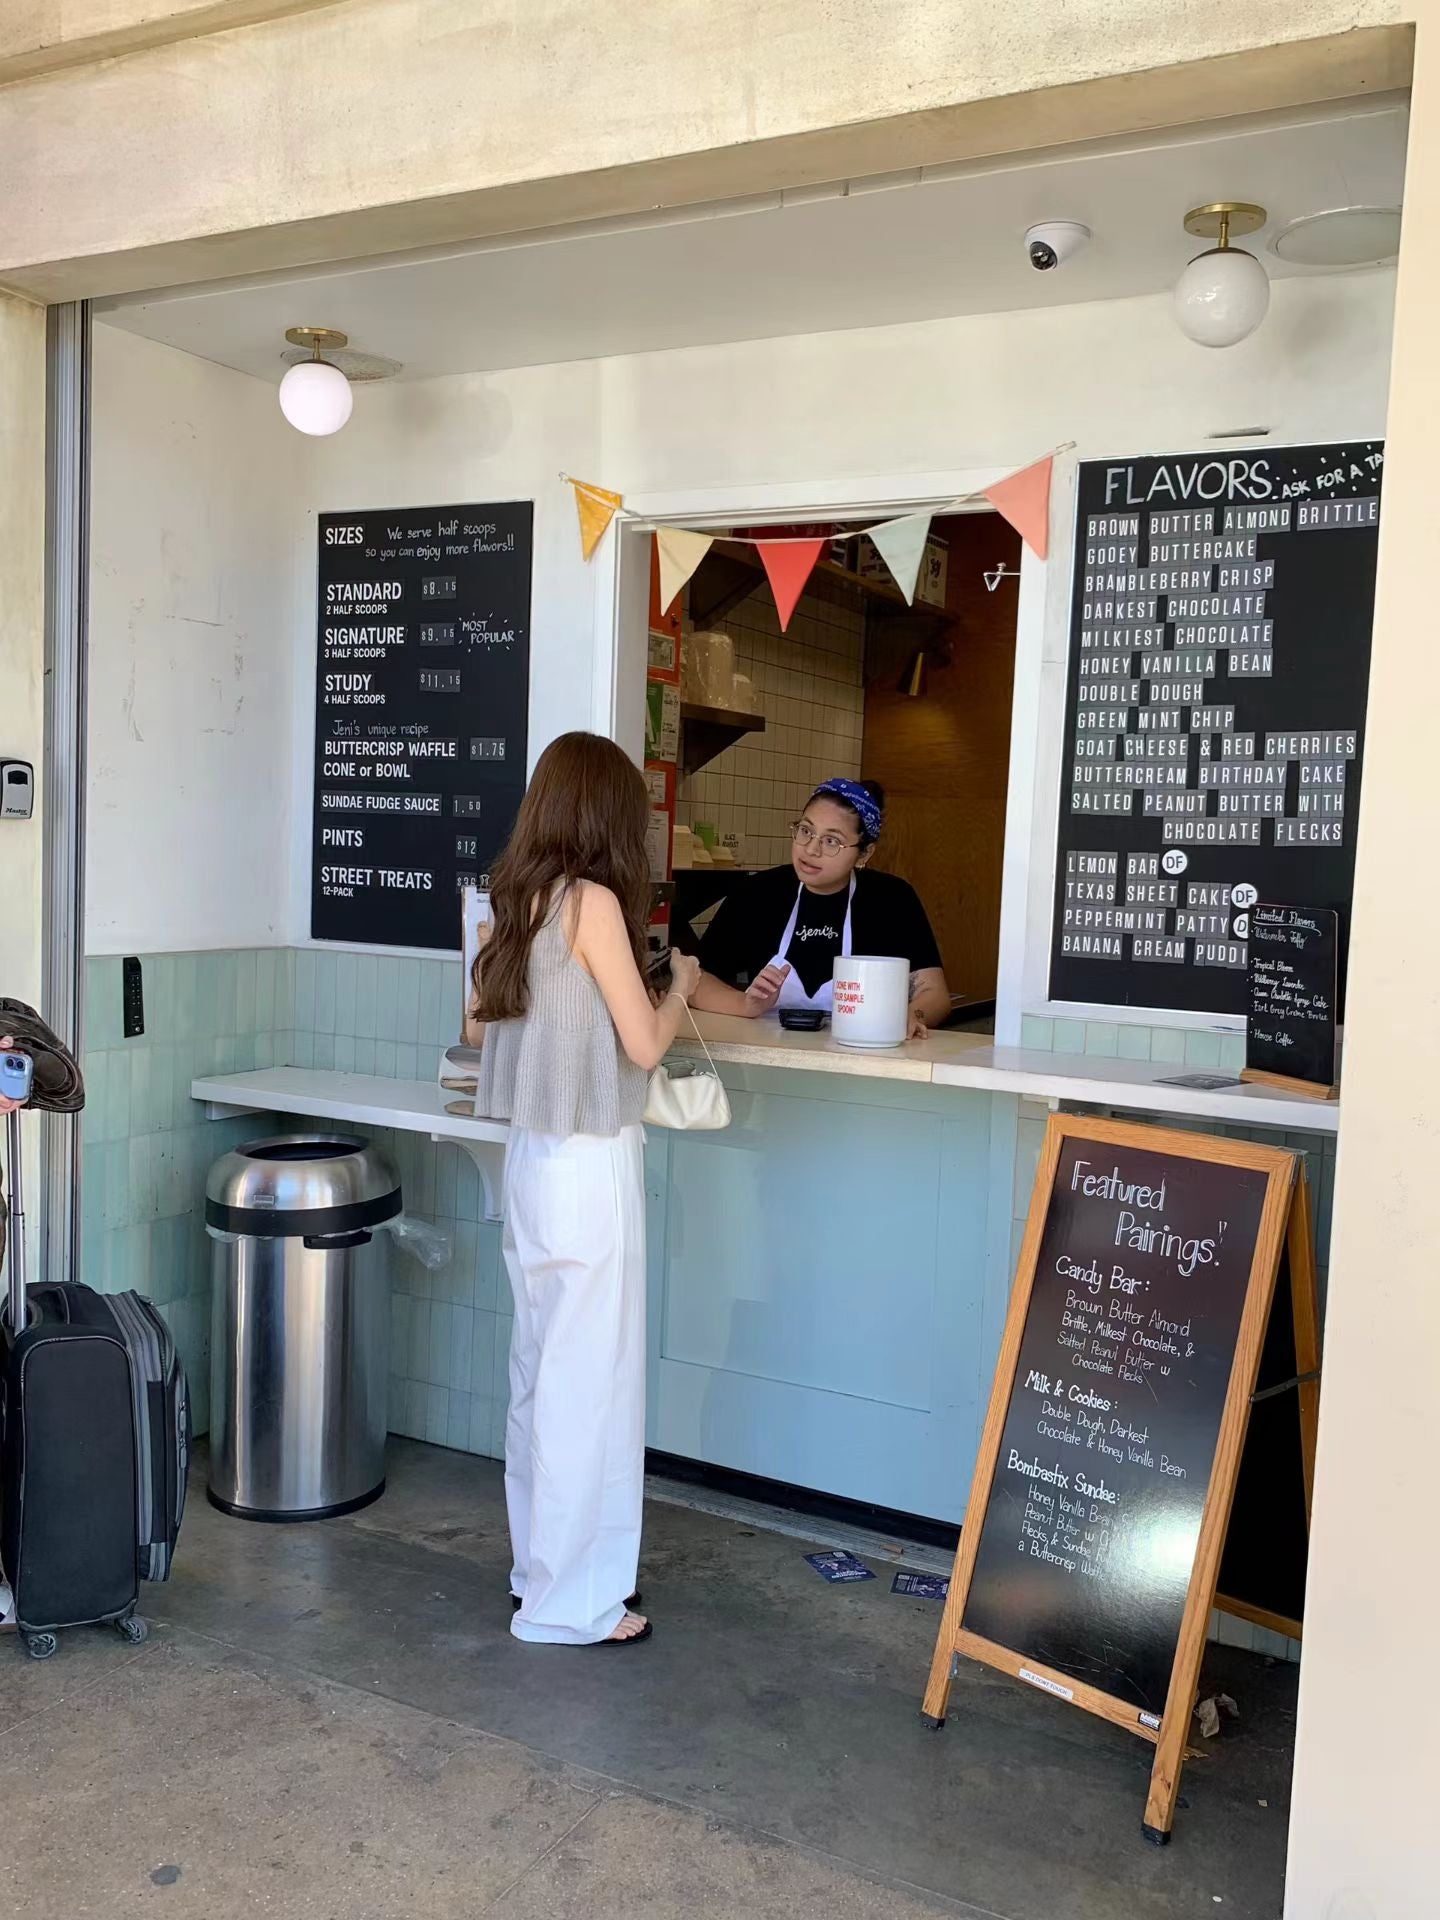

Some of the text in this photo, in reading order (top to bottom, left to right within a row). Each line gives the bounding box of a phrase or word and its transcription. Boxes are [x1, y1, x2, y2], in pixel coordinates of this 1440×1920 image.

[1104, 459, 1274, 506] FLAVORS
[1281, 463, 1364, 499] ASK FOR A
[387, 520, 496, 540] We serve half scoops
[1088, 502, 1377, 538] BROWN BUTTER ALMOND BRITTLE
[325, 526, 364, 545] SIZES
[365, 533, 515, 561] so you can enjoy more flavors!!
[1087, 539, 1255, 565] GOOEY BUTTERCAKE
[423, 581, 456, 595] $8.15
[1085, 566, 1274, 593] BRAMBLEBERRY CRISP
[326, 582, 402, 601] STANDARD
[326, 604, 387, 615] 2 HALF SCOOPS
[1084, 596, 1263, 621] DARKEST CHOCOLATE
[325, 627, 405, 645] SIGNATURE
[462, 620, 488, 632] MOST
[1081, 624, 1271, 648] MILKIEST CHOCOLATE
[470, 631, 515, 644] POPULAR
[324, 647, 386, 658] 3 HALF SCOOPS
[1080, 654, 1272, 675] HONEY VANILLA BEAN
[325, 674, 372, 692] STUDY
[420, 673, 461, 688] $11.15
[324, 694, 386, 704] 4 HALF SCOOPS
[1079, 683, 1202, 702] DOUBLE DOUGH
[332, 719, 429, 738] Jeni's unique recipe
[1077, 710, 1234, 729] GREEN MINT CHIP
[324, 741, 456, 757] BUTTERCRISP WAFFLE
[471, 742, 505, 757] $1.75
[1076, 736, 1355, 757] GOAT CHEESE & RED CHERRIES
[323, 762, 411, 778] CONE or BOWL
[1074, 765, 1344, 785] BUTTERCREAM BIRTHDAY CAKE
[322, 795, 440, 812] SUNDAE FUDGE SAUCE
[1072, 793, 1343, 813] SALTED PEANUT BUTTER WITH
[322, 829, 363, 847] PINTS
[1164, 821, 1341, 842] CHOCOLATE FLECKS
[457, 840, 476, 855] $12
[1068, 855, 1184, 876] LEMON BAR DF
[321, 866, 432, 890] STREET TREATS
[323, 886, 354, 897] 12-PACK
[1067, 882, 1254, 906] TEXAS SHEET CAKE DF
[1065, 909, 1228, 933] PEPPERMINT PATTY
[795, 924, 839, 941] jeni's
[1063, 935, 1247, 964] BANANA CREAM PUDDI
[1071, 1161, 1166, 1212] Featured
[1055, 1255, 1151, 1295] Candy Bar:
[1065, 1289, 1191, 1337] Brown Butter Almond
[1056, 1331, 1086, 1351] Salted
[1090, 1340, 1119, 1361] Peanut
[1125, 1348, 1155, 1371] Butter
[1132, 1330, 1181, 1357] Chocolate,
[1185, 1342, 1195, 1357] &
[1071, 1353, 1143, 1384] Chocolate Flecks
[1024, 1370, 1051, 1394] Milk
[1053, 1379, 1064, 1398] &
[1041, 1401, 1149, 1445] Double Dough, Darkest
[1036, 1420, 1187, 1479] Chocolate & Honey Vanilla Bean
[1007, 1449, 1121, 1504] Bombastix Sundae:
[1028, 1483, 1055, 1511] Honey
[1059, 1493, 1085, 1518] Vanilla
[1024, 1502, 1054, 1526] Peanut
[1056, 1513, 1080, 1536] Butter
[1050, 1532, 1059, 1546] &
[1062, 1535, 1092, 1557] Sundae
[1018, 1540, 1025, 1551] a
[1030, 1540, 1076, 1573] Buttercrisp
